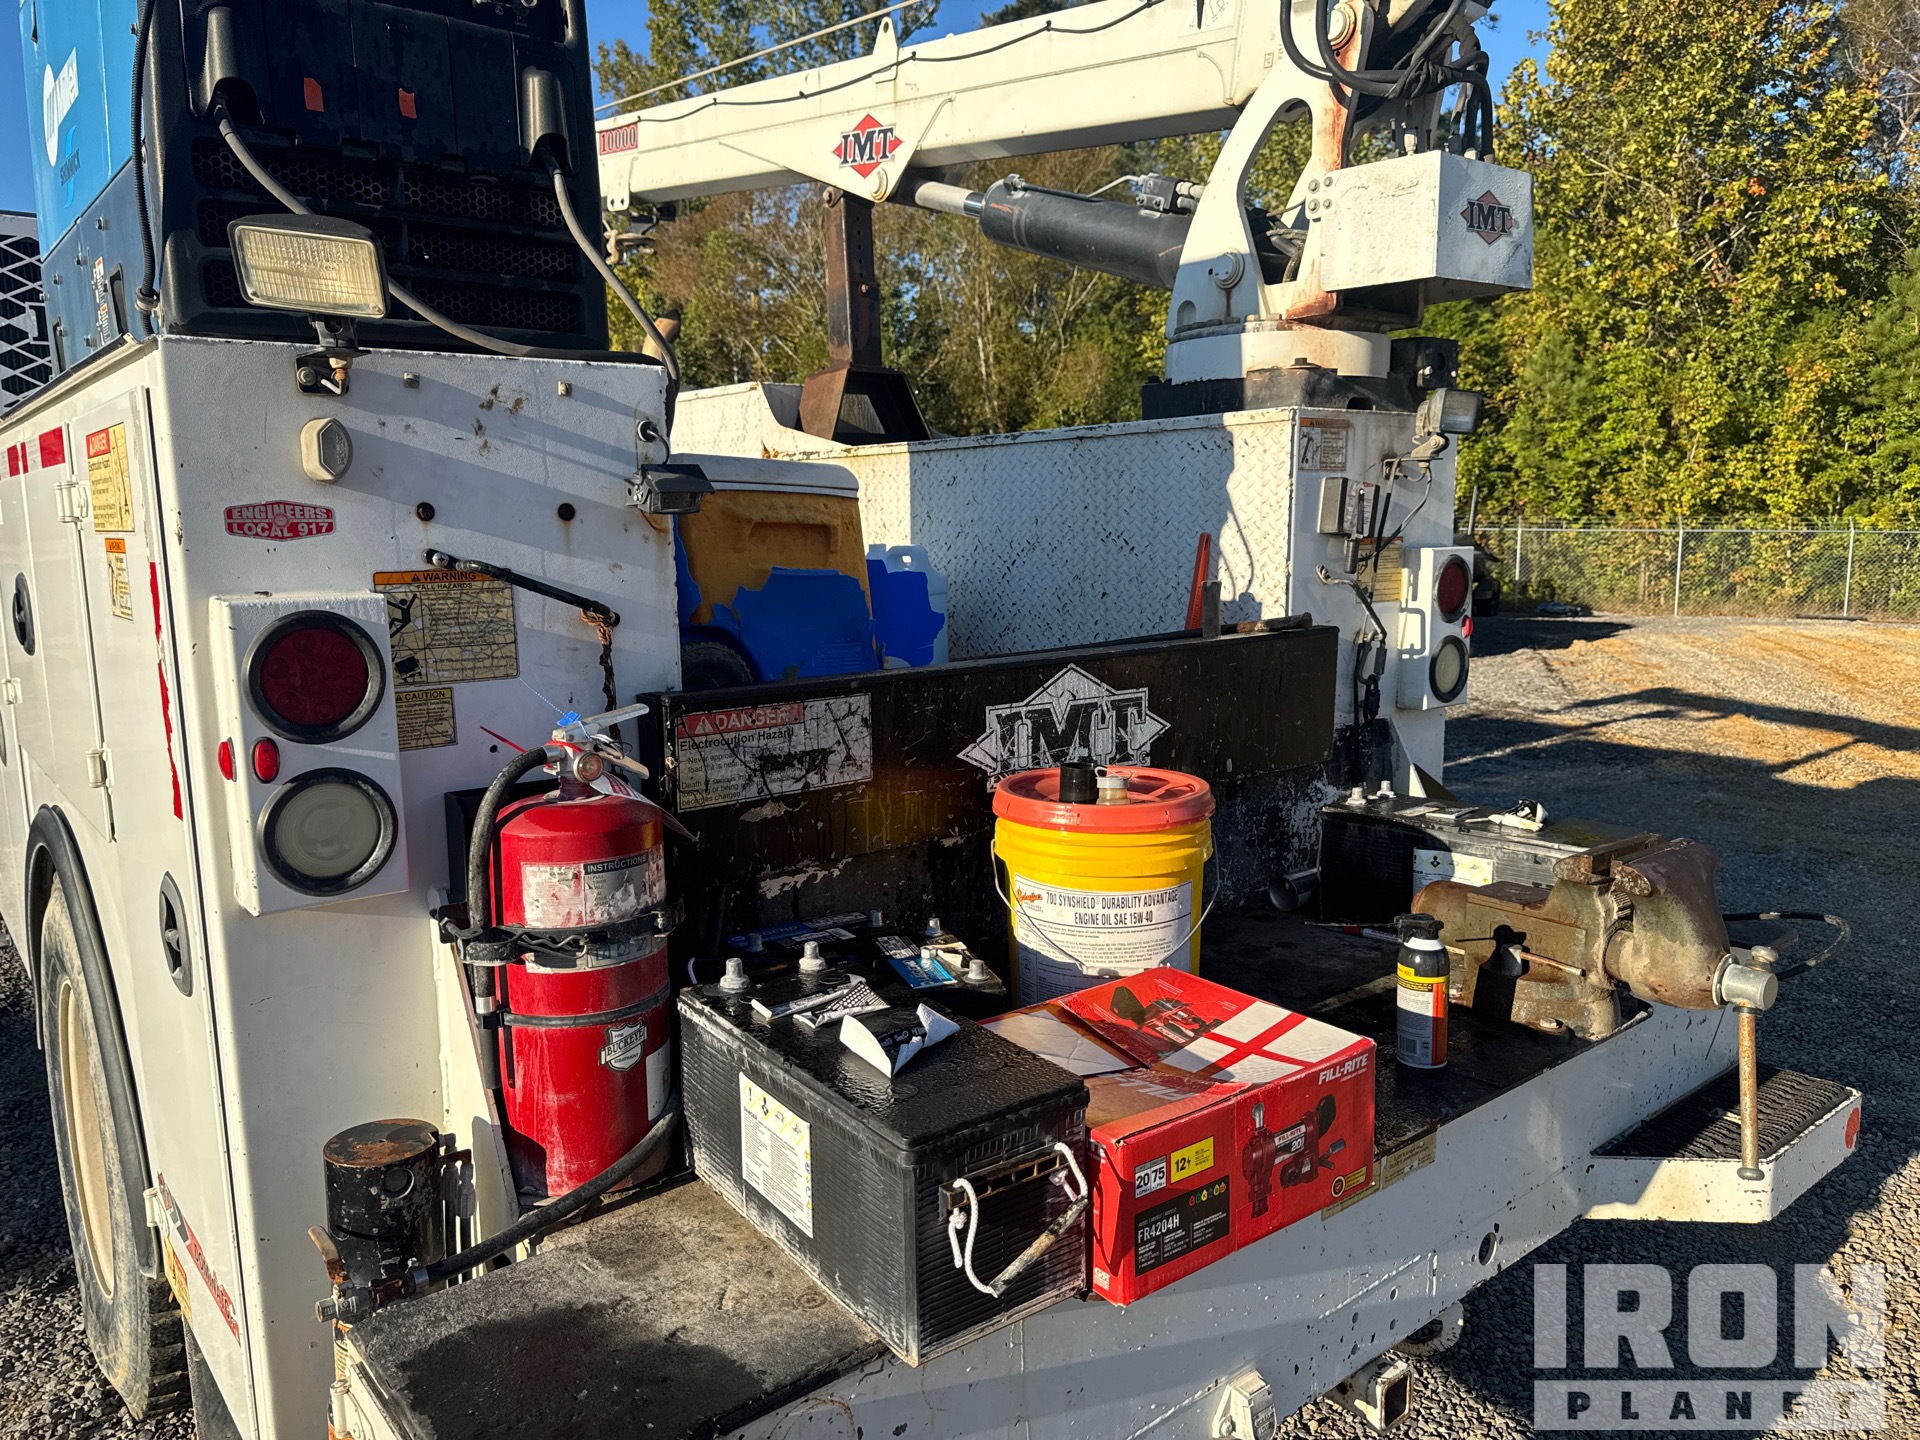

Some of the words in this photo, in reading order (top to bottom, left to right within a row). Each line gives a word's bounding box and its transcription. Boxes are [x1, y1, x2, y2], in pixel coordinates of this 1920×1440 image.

[600, 126, 637, 152] 10000
[840, 126, 896, 165] IMT
[1466, 201, 1510, 232] IMT
[232, 504, 327, 519] ENGINEERS
[232, 522, 293, 537] LOCAL
[298, 522, 328, 536] 917
[423, 572, 476, 582] WARNING
[404, 690, 445, 700] CAUTION
[714, 706, 788, 730] DANGER
[680, 733, 754, 750] Electrocution
[758, 727, 793, 740] Hazard
[995, 697, 1145, 766] IMT
[587, 854, 648, 872] INSTRUCTIONS
[1046, 892, 1057, 906] 700
[1102, 896, 1142, 910] DURABILITY
[1143, 889, 1178, 908] ADVANTAGE
[1074, 912, 1100, 926] ENGINE
[1102, 913, 1114, 926] OIL
[1114, 912, 1127, 926] SAE
[606, 1028, 642, 1056] BUCKEYE
[1318, 1053, 1368, 1085] FILL-RITE
[1290, 1138, 1302, 1152] 20
[1136, 1172, 1150, 1190] 20
[1152, 1166, 1165, 1183] 75
[1138, 1213, 1180, 1244] FR4204H
